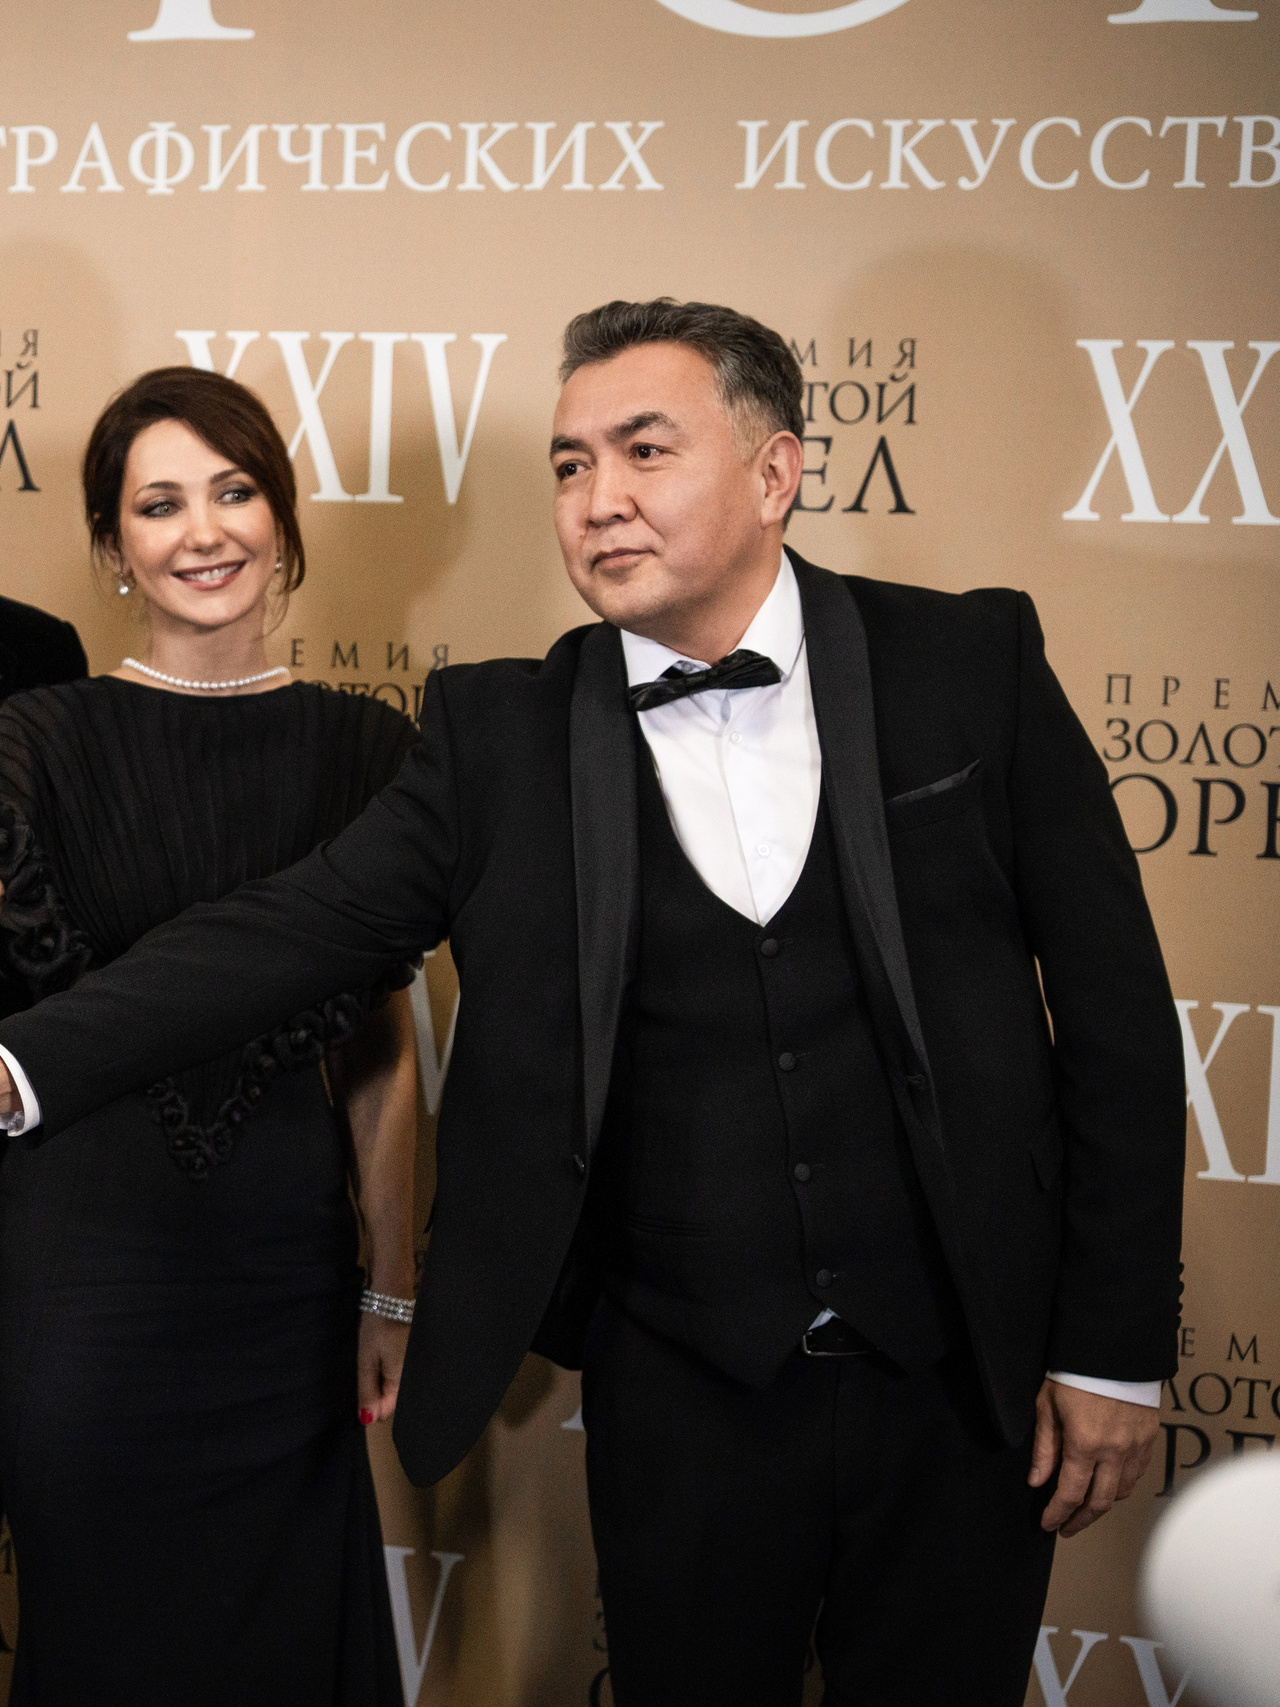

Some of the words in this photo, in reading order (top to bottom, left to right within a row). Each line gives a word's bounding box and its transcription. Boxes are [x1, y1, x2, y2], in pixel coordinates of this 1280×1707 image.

[734, 115, 1280, 192] ИСКУССТВ
[174, 330, 508, 505] XIV
[291, 637, 449, 671] ЕМИЯ
[1103, 717, 1280, 769] ЗОЛО
